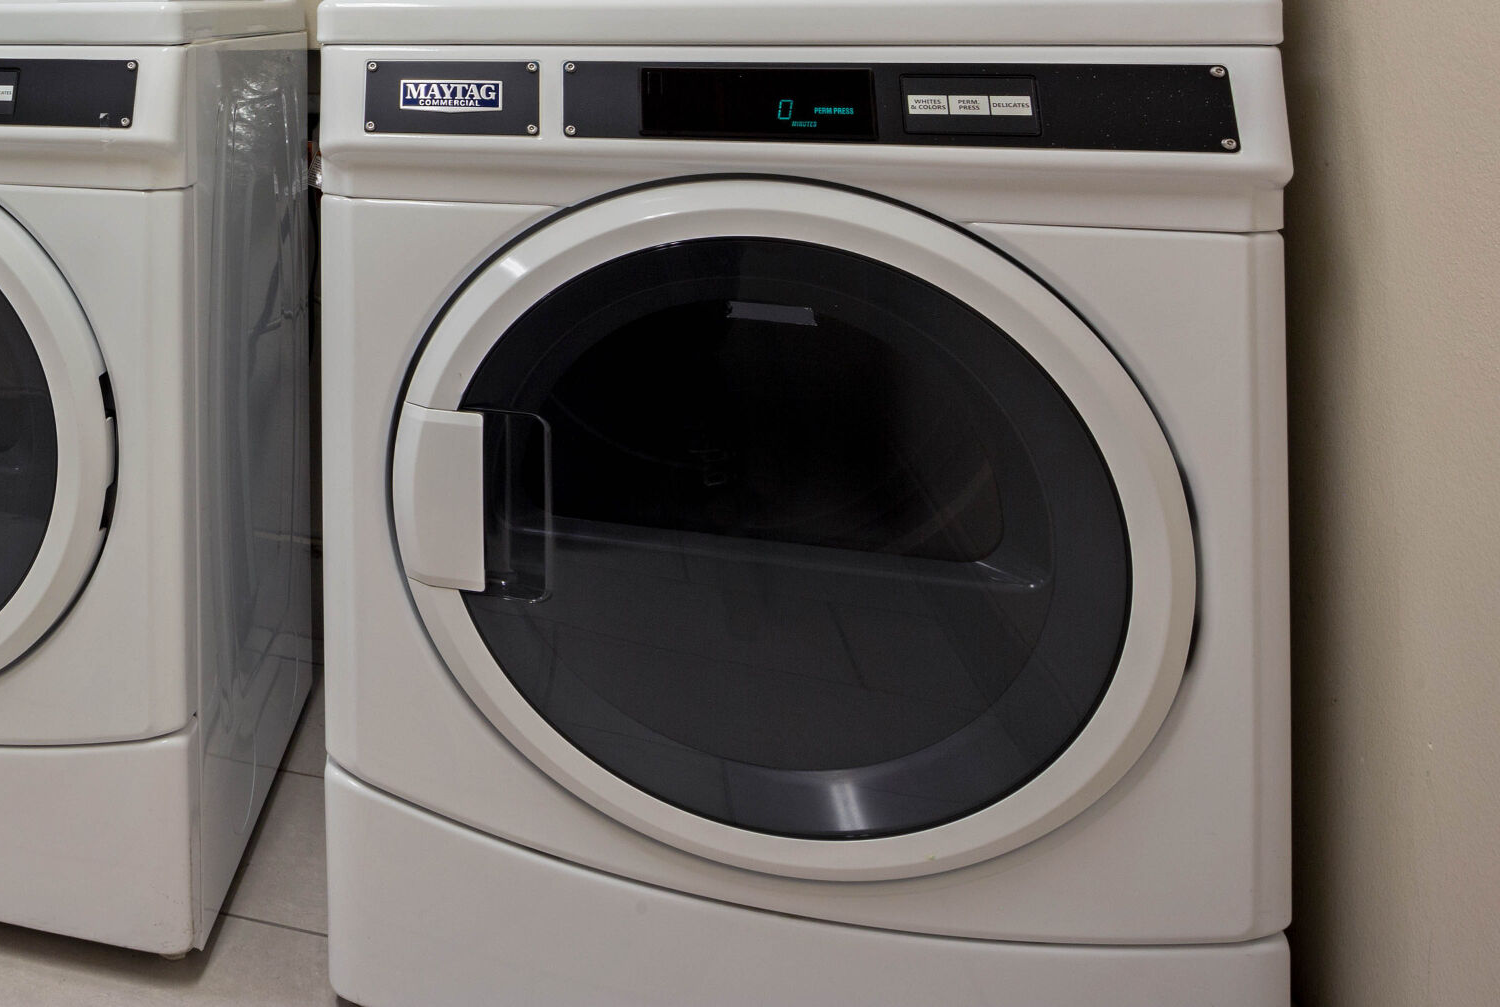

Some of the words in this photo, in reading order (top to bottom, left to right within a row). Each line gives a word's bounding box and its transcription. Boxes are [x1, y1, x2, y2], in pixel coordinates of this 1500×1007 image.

[405, 83, 496, 100] MAYTAG
[419, 99, 481, 107] COMMERCIAL
[777, 99, 794, 120] 0
[814, 107, 832, 115] PERM
[833, 107, 854, 115] PRESS
